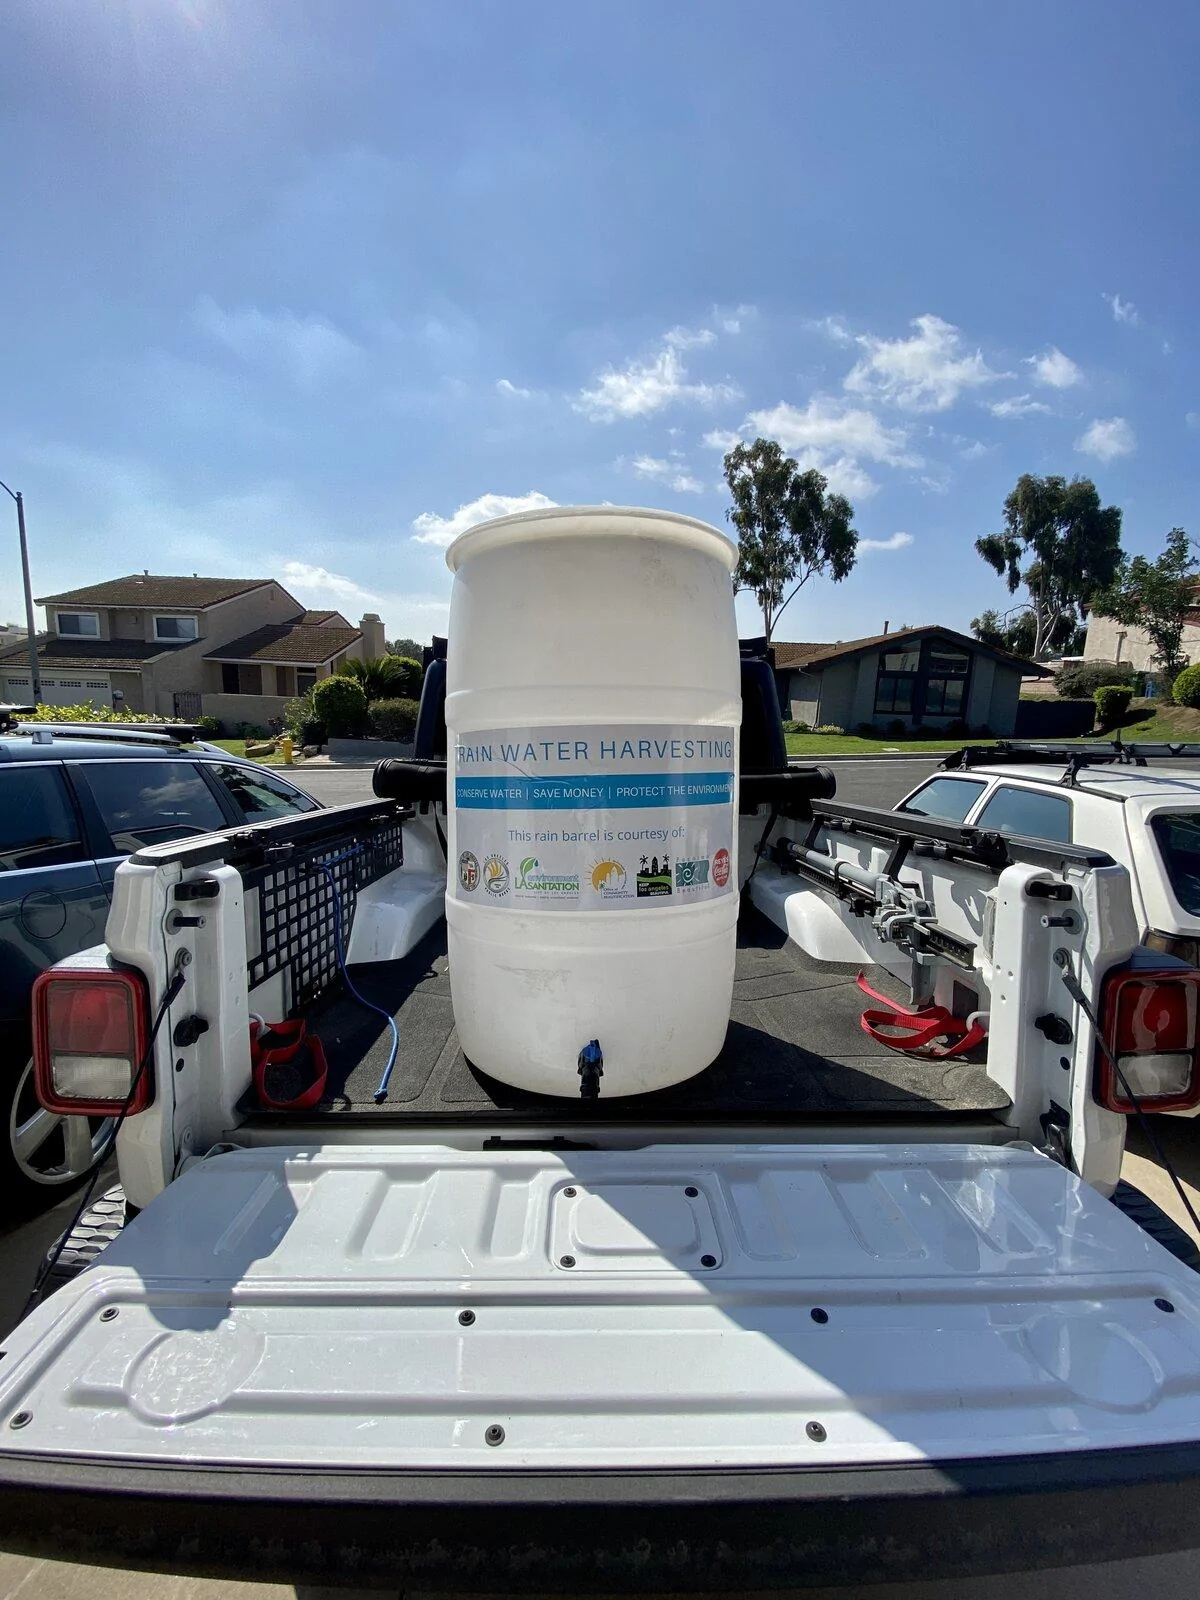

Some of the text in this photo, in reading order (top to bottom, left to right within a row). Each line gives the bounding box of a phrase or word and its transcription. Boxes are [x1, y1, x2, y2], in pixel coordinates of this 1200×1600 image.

[458, 740, 732, 762] RAIN WATER HARVESTING
[456, 783, 732, 799] CONSERVE WATER SAVE MONEY PROTECT THE ENVIRONMEN
[508, 826, 686, 842] This rain barrel is courtesy of:
[528, 882, 580, 891] SANITATION
